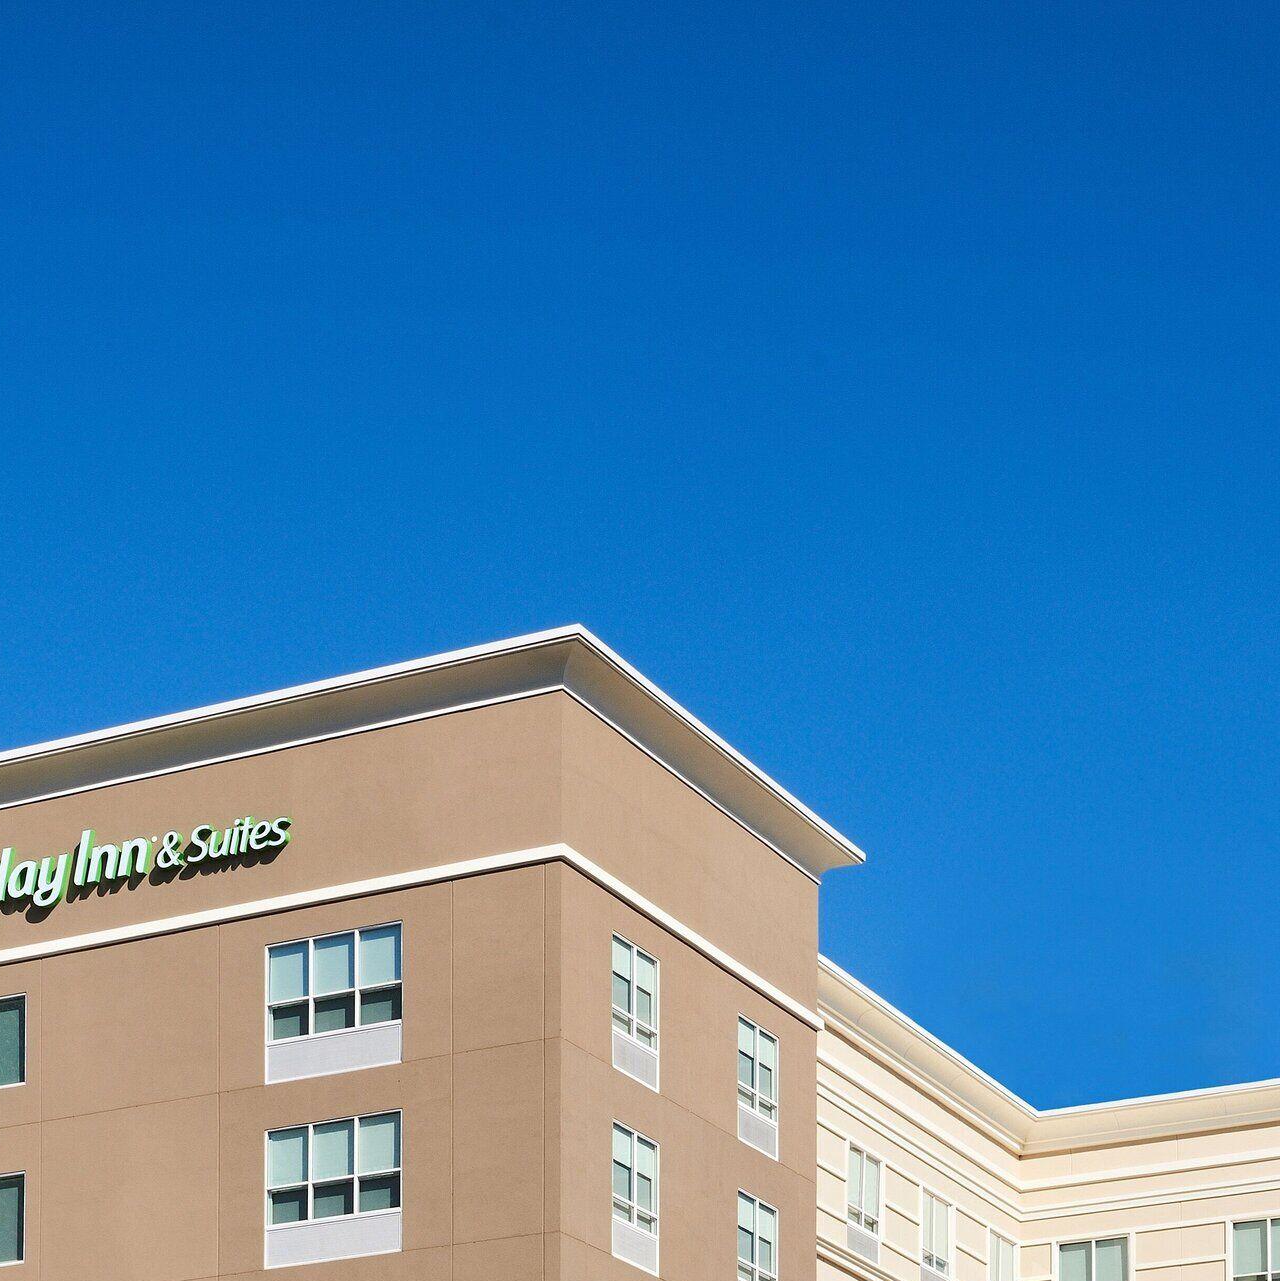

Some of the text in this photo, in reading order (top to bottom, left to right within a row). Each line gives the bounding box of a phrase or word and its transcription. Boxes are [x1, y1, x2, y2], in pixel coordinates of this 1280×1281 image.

[73, 828, 152, 886] Inn
[156, 830, 184, 869] &
[187, 816, 292, 862] Suites
